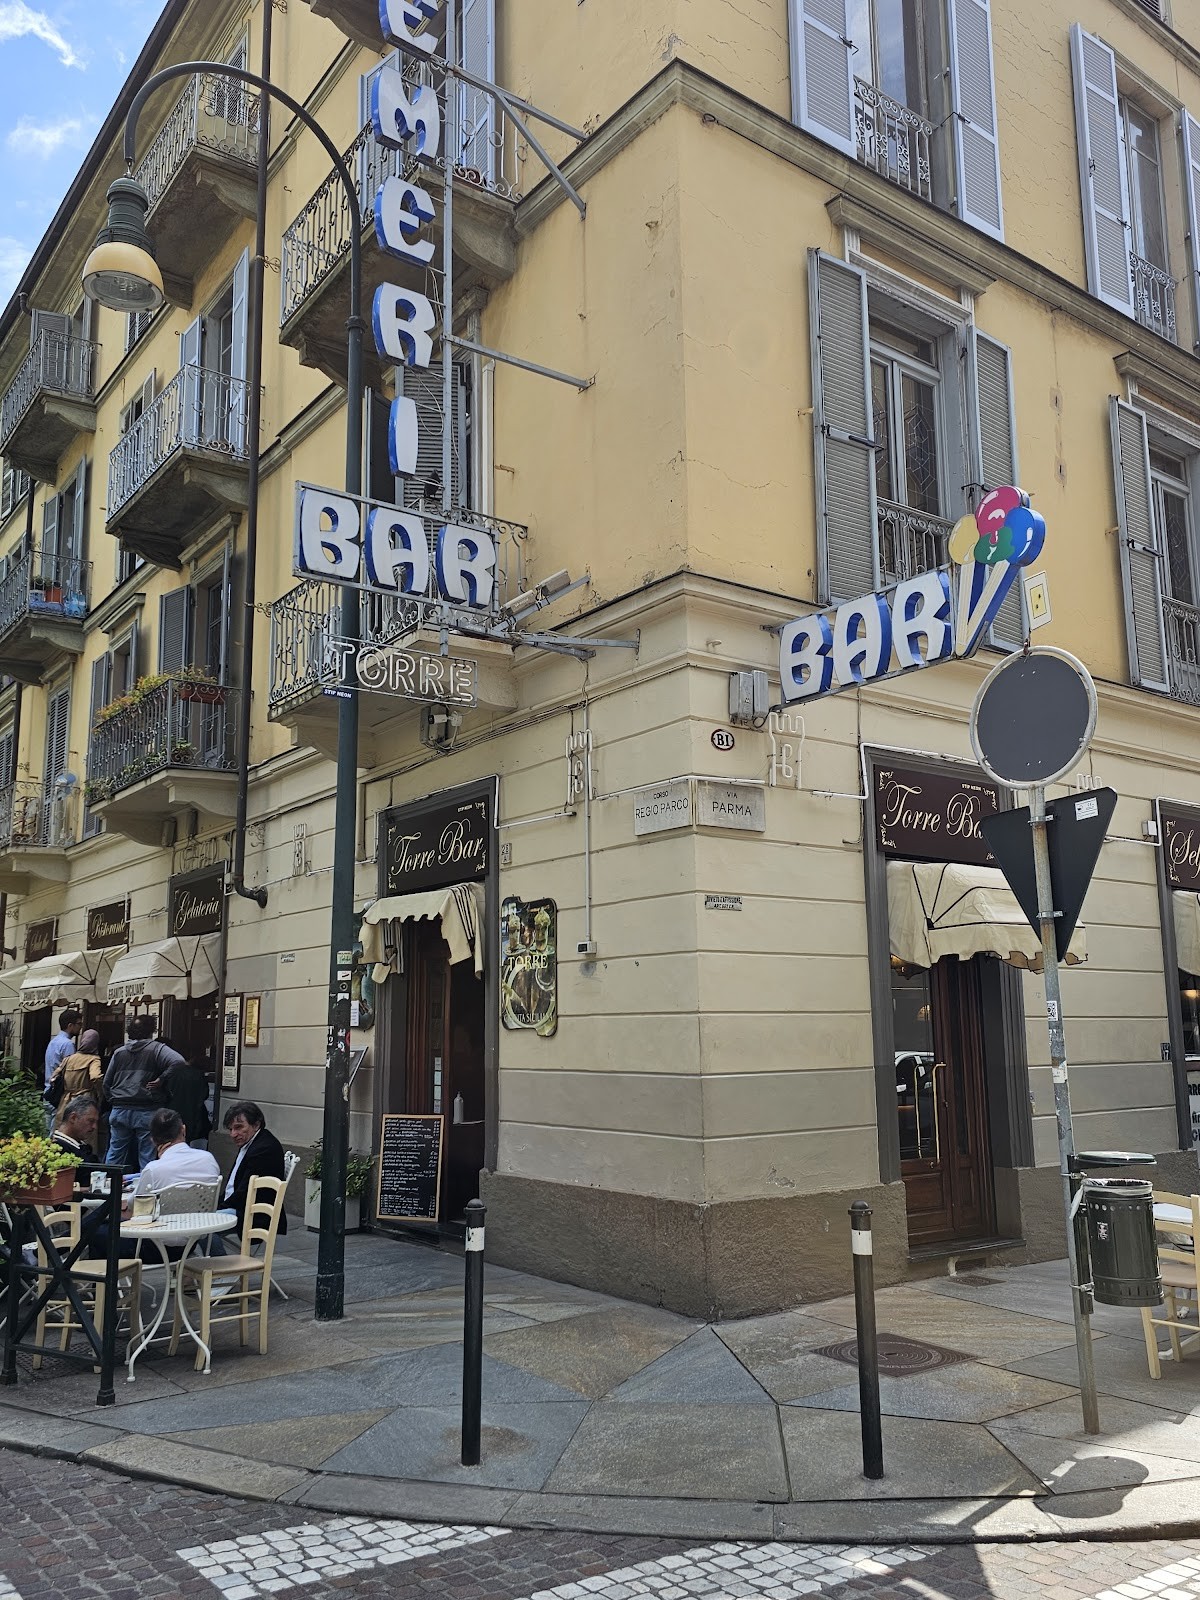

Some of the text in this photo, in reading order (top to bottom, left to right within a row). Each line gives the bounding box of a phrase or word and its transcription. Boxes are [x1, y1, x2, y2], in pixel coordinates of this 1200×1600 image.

[301, 489, 496, 610] BAR
[779, 571, 952, 702] BAR
[326, 640, 473, 702] TORRE
[635, 798, 689, 819] REGIO PARCO
[653, 790, 669, 799] CORSO
[712, 801, 752, 816] PARMA
[726, 791, 738, 799] VIA
[883, 780, 984, 840] Torre Ba
[391, 818, 484, 876] Torre Bar
[91, 912, 126, 940] Ristorante
[175, 891, 220, 931] Gelateria
[507, 954, 548, 971] TORRE
